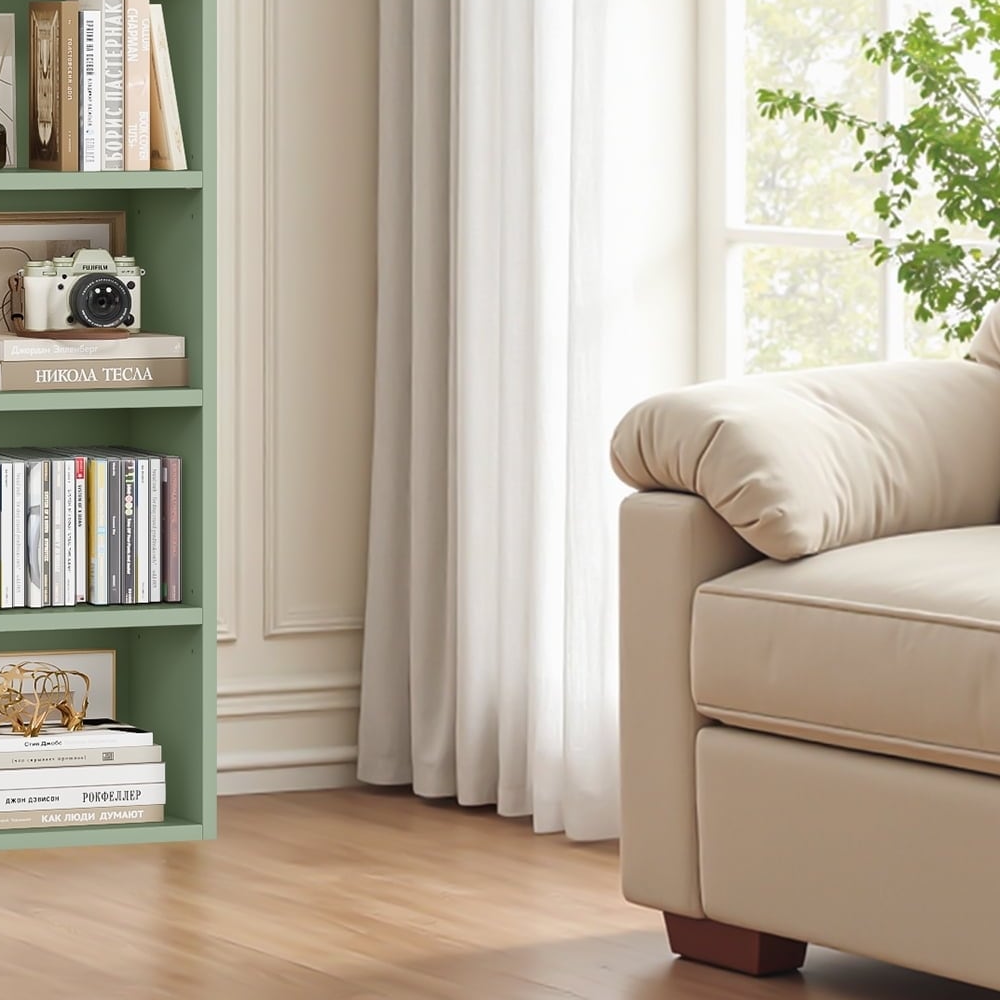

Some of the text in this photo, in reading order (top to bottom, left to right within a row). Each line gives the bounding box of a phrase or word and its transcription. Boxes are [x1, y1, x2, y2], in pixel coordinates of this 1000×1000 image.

[127, 7, 138, 62] CHAPMAN
[105, 2, 123, 162] БОРИС ПАСТЕРНАК
[35, 367, 153, 383] НИКОЛА ТЕСЛА
[5, 795, 60, 804] ДЖОН ДЭВИСОН
[82, 789, 142, 803] РОКФЕЛЛЕР
[41, 814, 62, 824] КАК
[63, 812, 96, 823] ЛЮДИ
[100, 809, 144, 822] ДУМАЮТ
